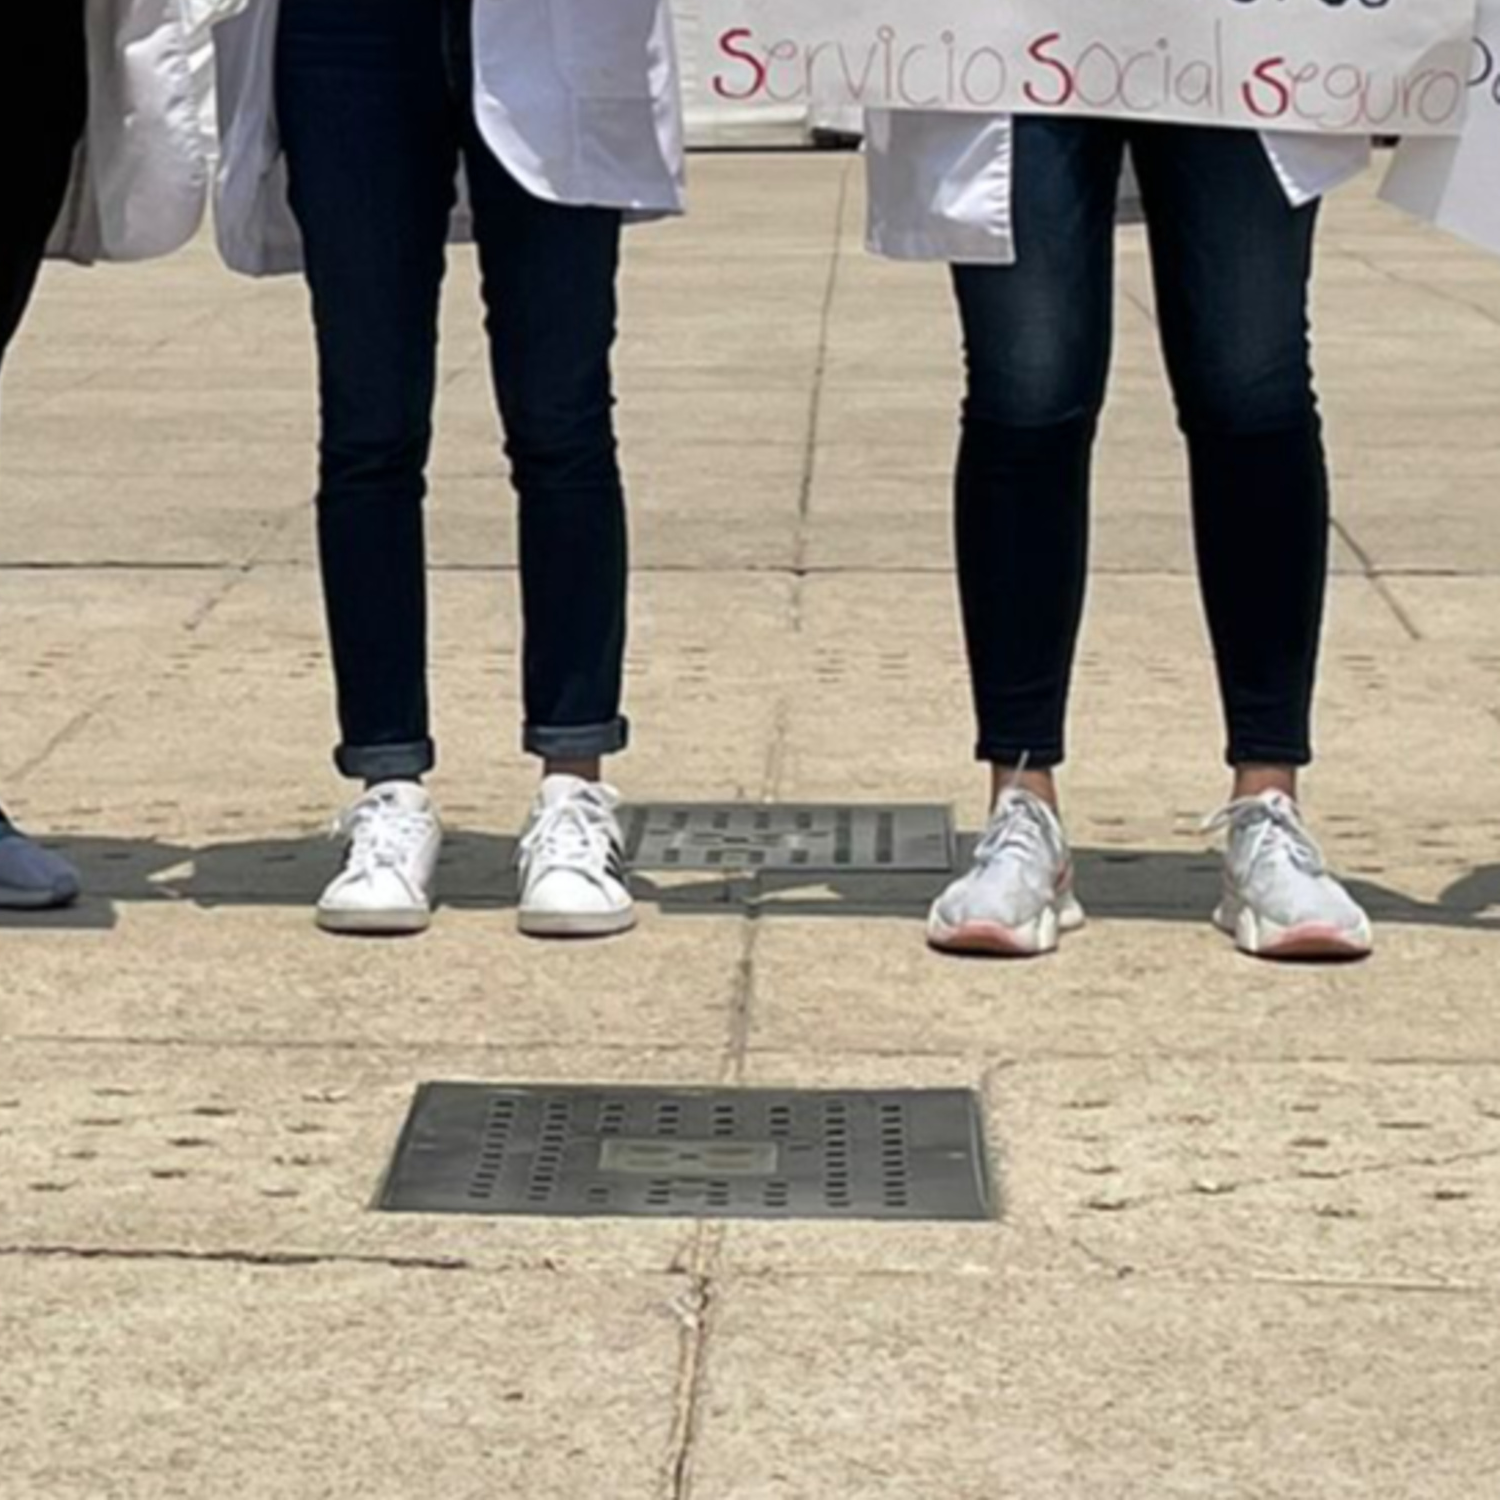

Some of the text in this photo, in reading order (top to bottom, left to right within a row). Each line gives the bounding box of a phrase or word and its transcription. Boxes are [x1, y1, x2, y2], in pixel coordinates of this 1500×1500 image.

[713, 25, 1007, 103] Servicio
[1023, 17, 1224, 117] Social
[1242, 56, 1462, 129] Seguro
